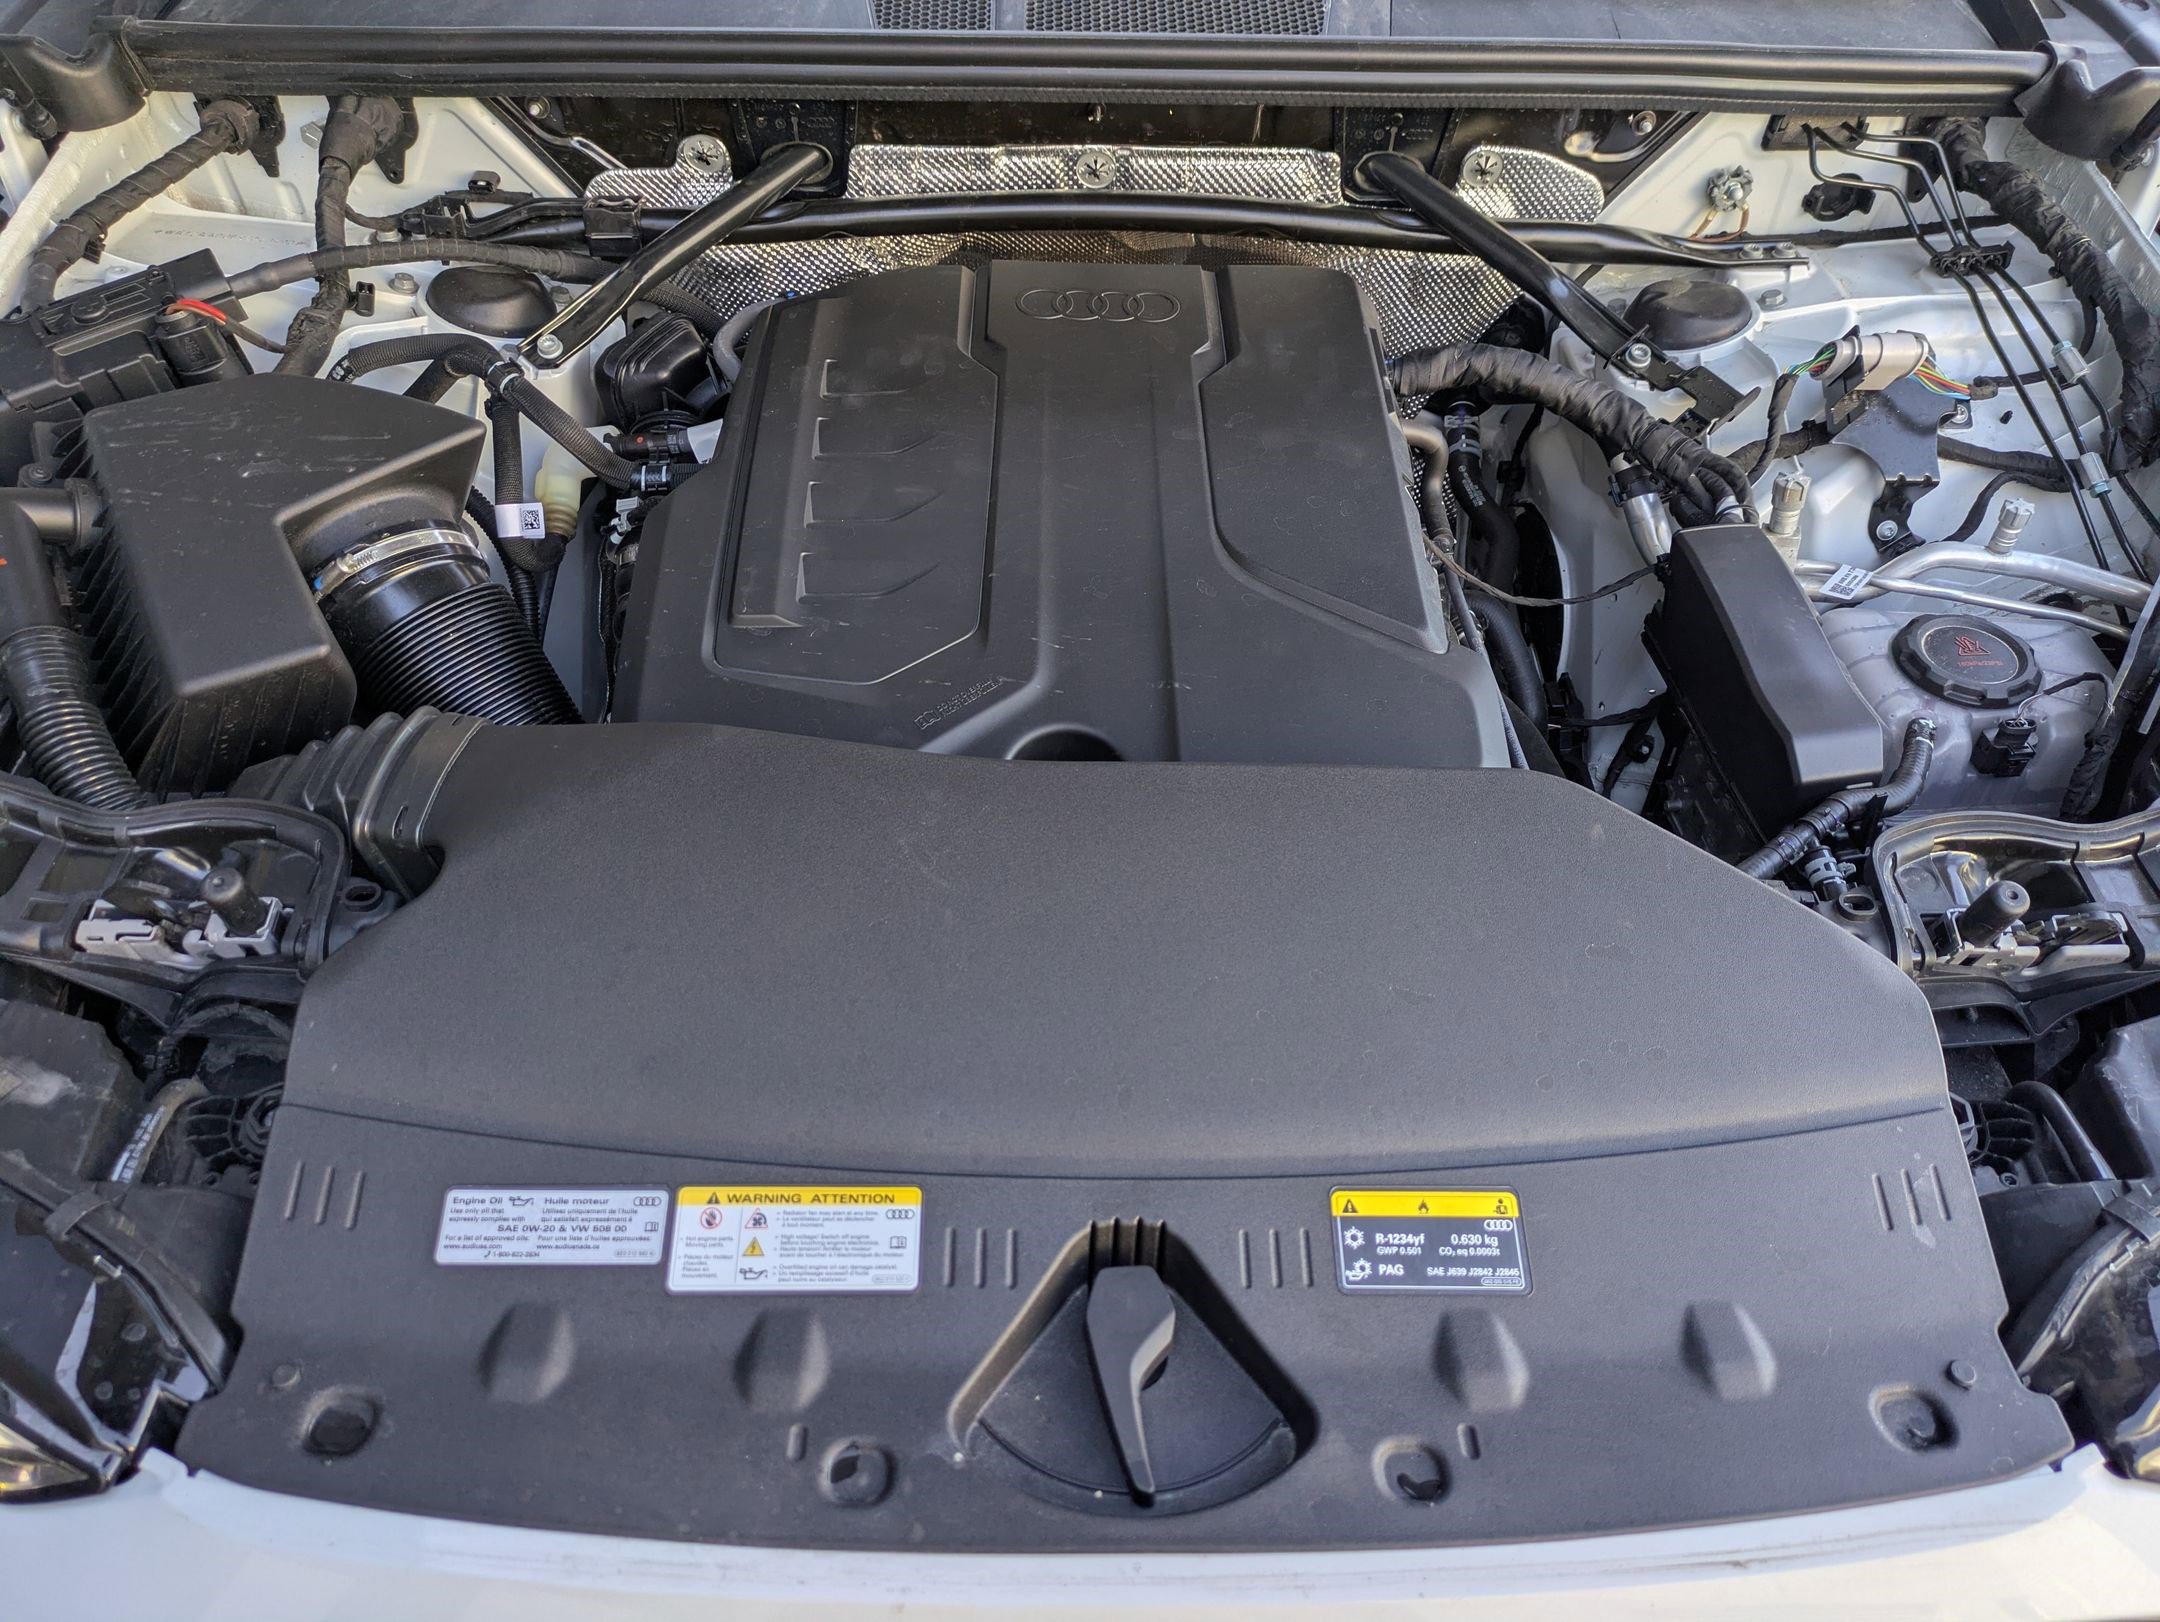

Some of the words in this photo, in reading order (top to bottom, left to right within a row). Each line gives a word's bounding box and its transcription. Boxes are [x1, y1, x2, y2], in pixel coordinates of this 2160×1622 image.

[453, 1196, 486, 1205] Engine
[544, 1197, 569, 1205] Huile
[572, 1197, 610, 1205] moteur
[727, 1193, 801, 1204] WARNING
[811, 1193, 895, 1204] ATTENTION
[1375, 1233, 1425, 1244] R-1234yf
[1451, 1234, 1483, 1244] 0.630
[1484, 1234, 1499, 1247] kg
[1377, 1247, 1398, 1255] GWP
[1378, 1264, 1404, 1275] PAG
[1427, 1266, 1445, 1276] SAE
